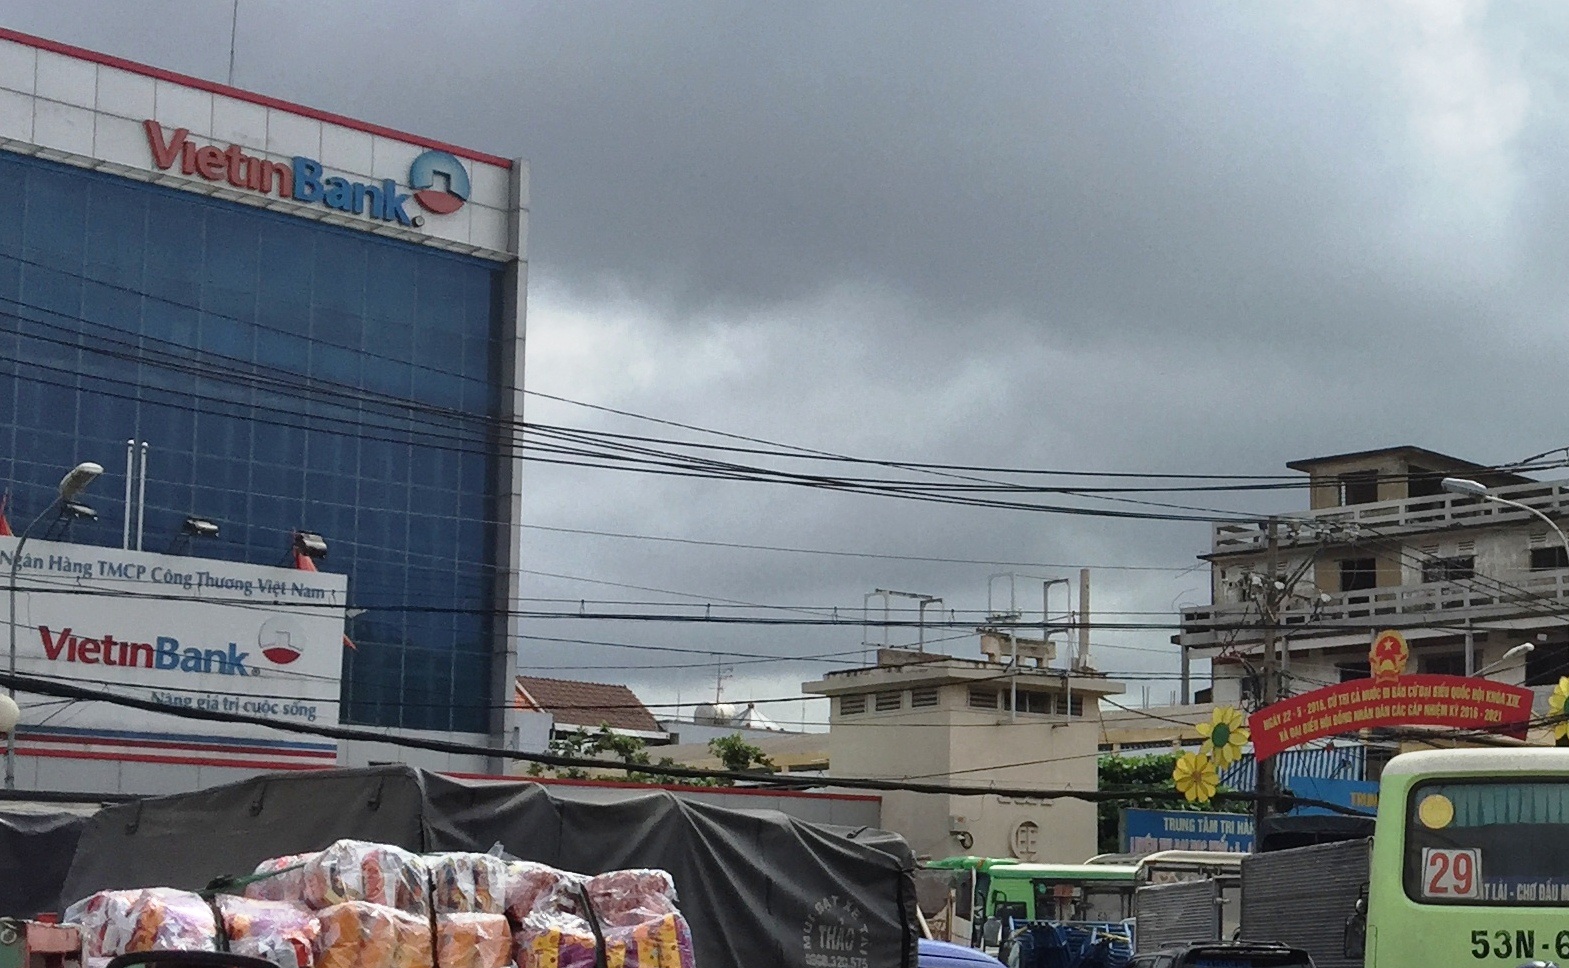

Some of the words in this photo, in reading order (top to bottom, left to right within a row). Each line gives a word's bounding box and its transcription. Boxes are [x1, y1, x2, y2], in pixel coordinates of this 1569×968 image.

[143, 120, 411, 227] VietinBank
[49, 554, 92, 578] Hàng
[98, 560, 146, 580] TMCP
[151, 567, 192, 589] Công
[258, 578, 286, 597] Việt
[291, 582, 325, 599] Nam
[39, 625, 249, 677] VietinBank
[283, 699, 317, 722] sống
[1163, 816, 1196, 832] TRUNG
[1197, 816, 1218, 834] TÂM
[1429, 852, 1473, 894] 29
